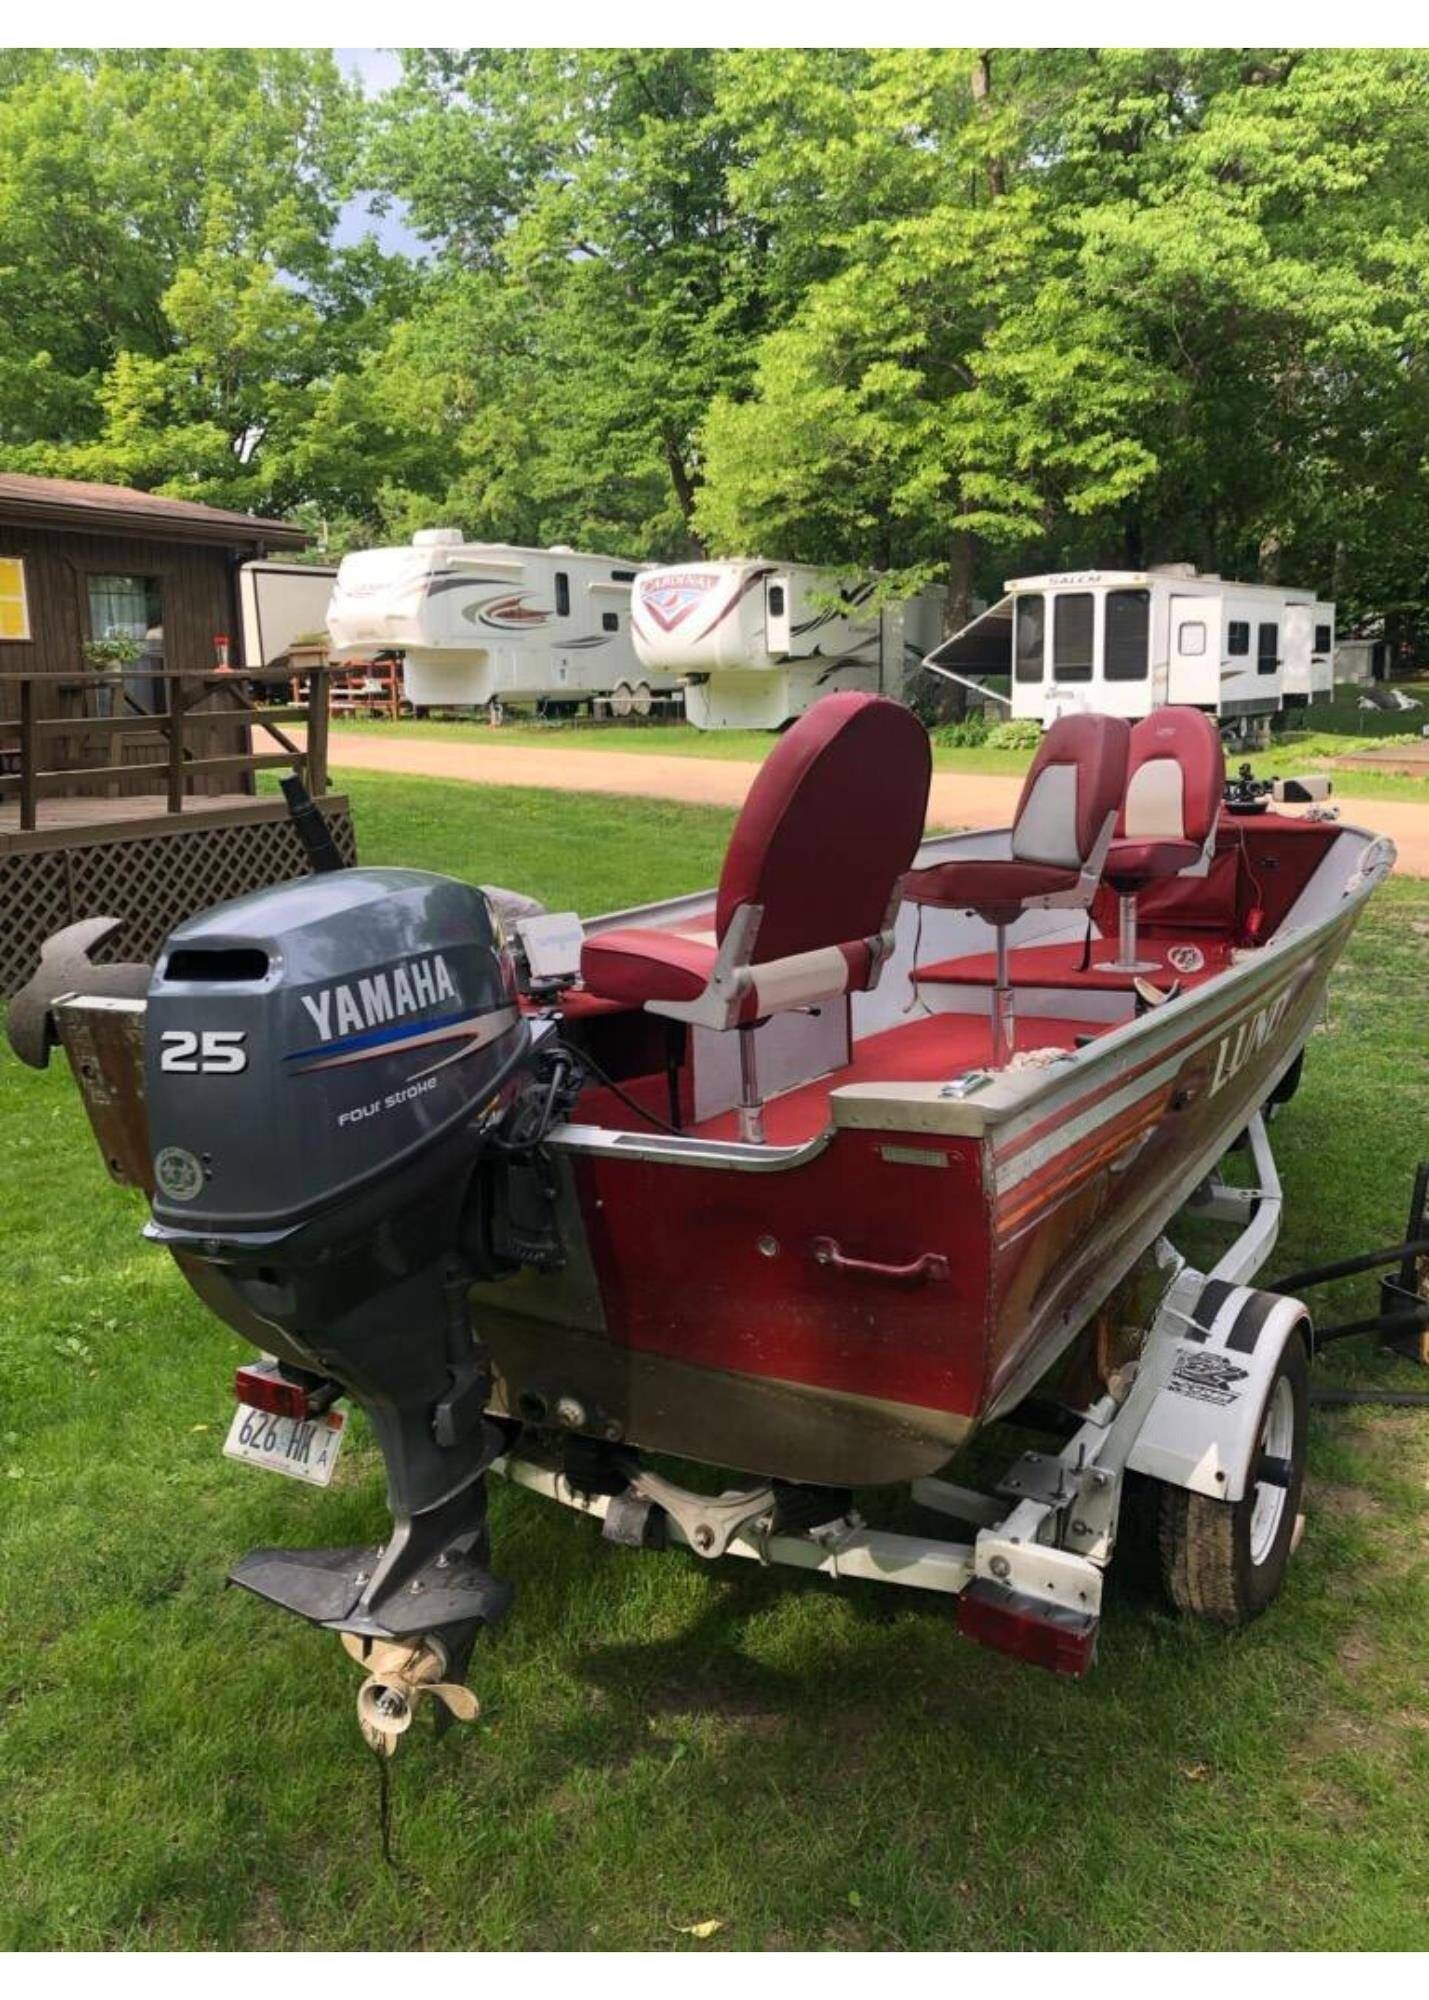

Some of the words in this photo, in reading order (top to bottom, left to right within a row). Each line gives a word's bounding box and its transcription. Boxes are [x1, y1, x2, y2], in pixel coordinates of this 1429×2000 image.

[301, 954, 455, 1041] YAMAHA
[161, 1031, 246, 1071] 25
[239, 1410, 277, 1452] 626
